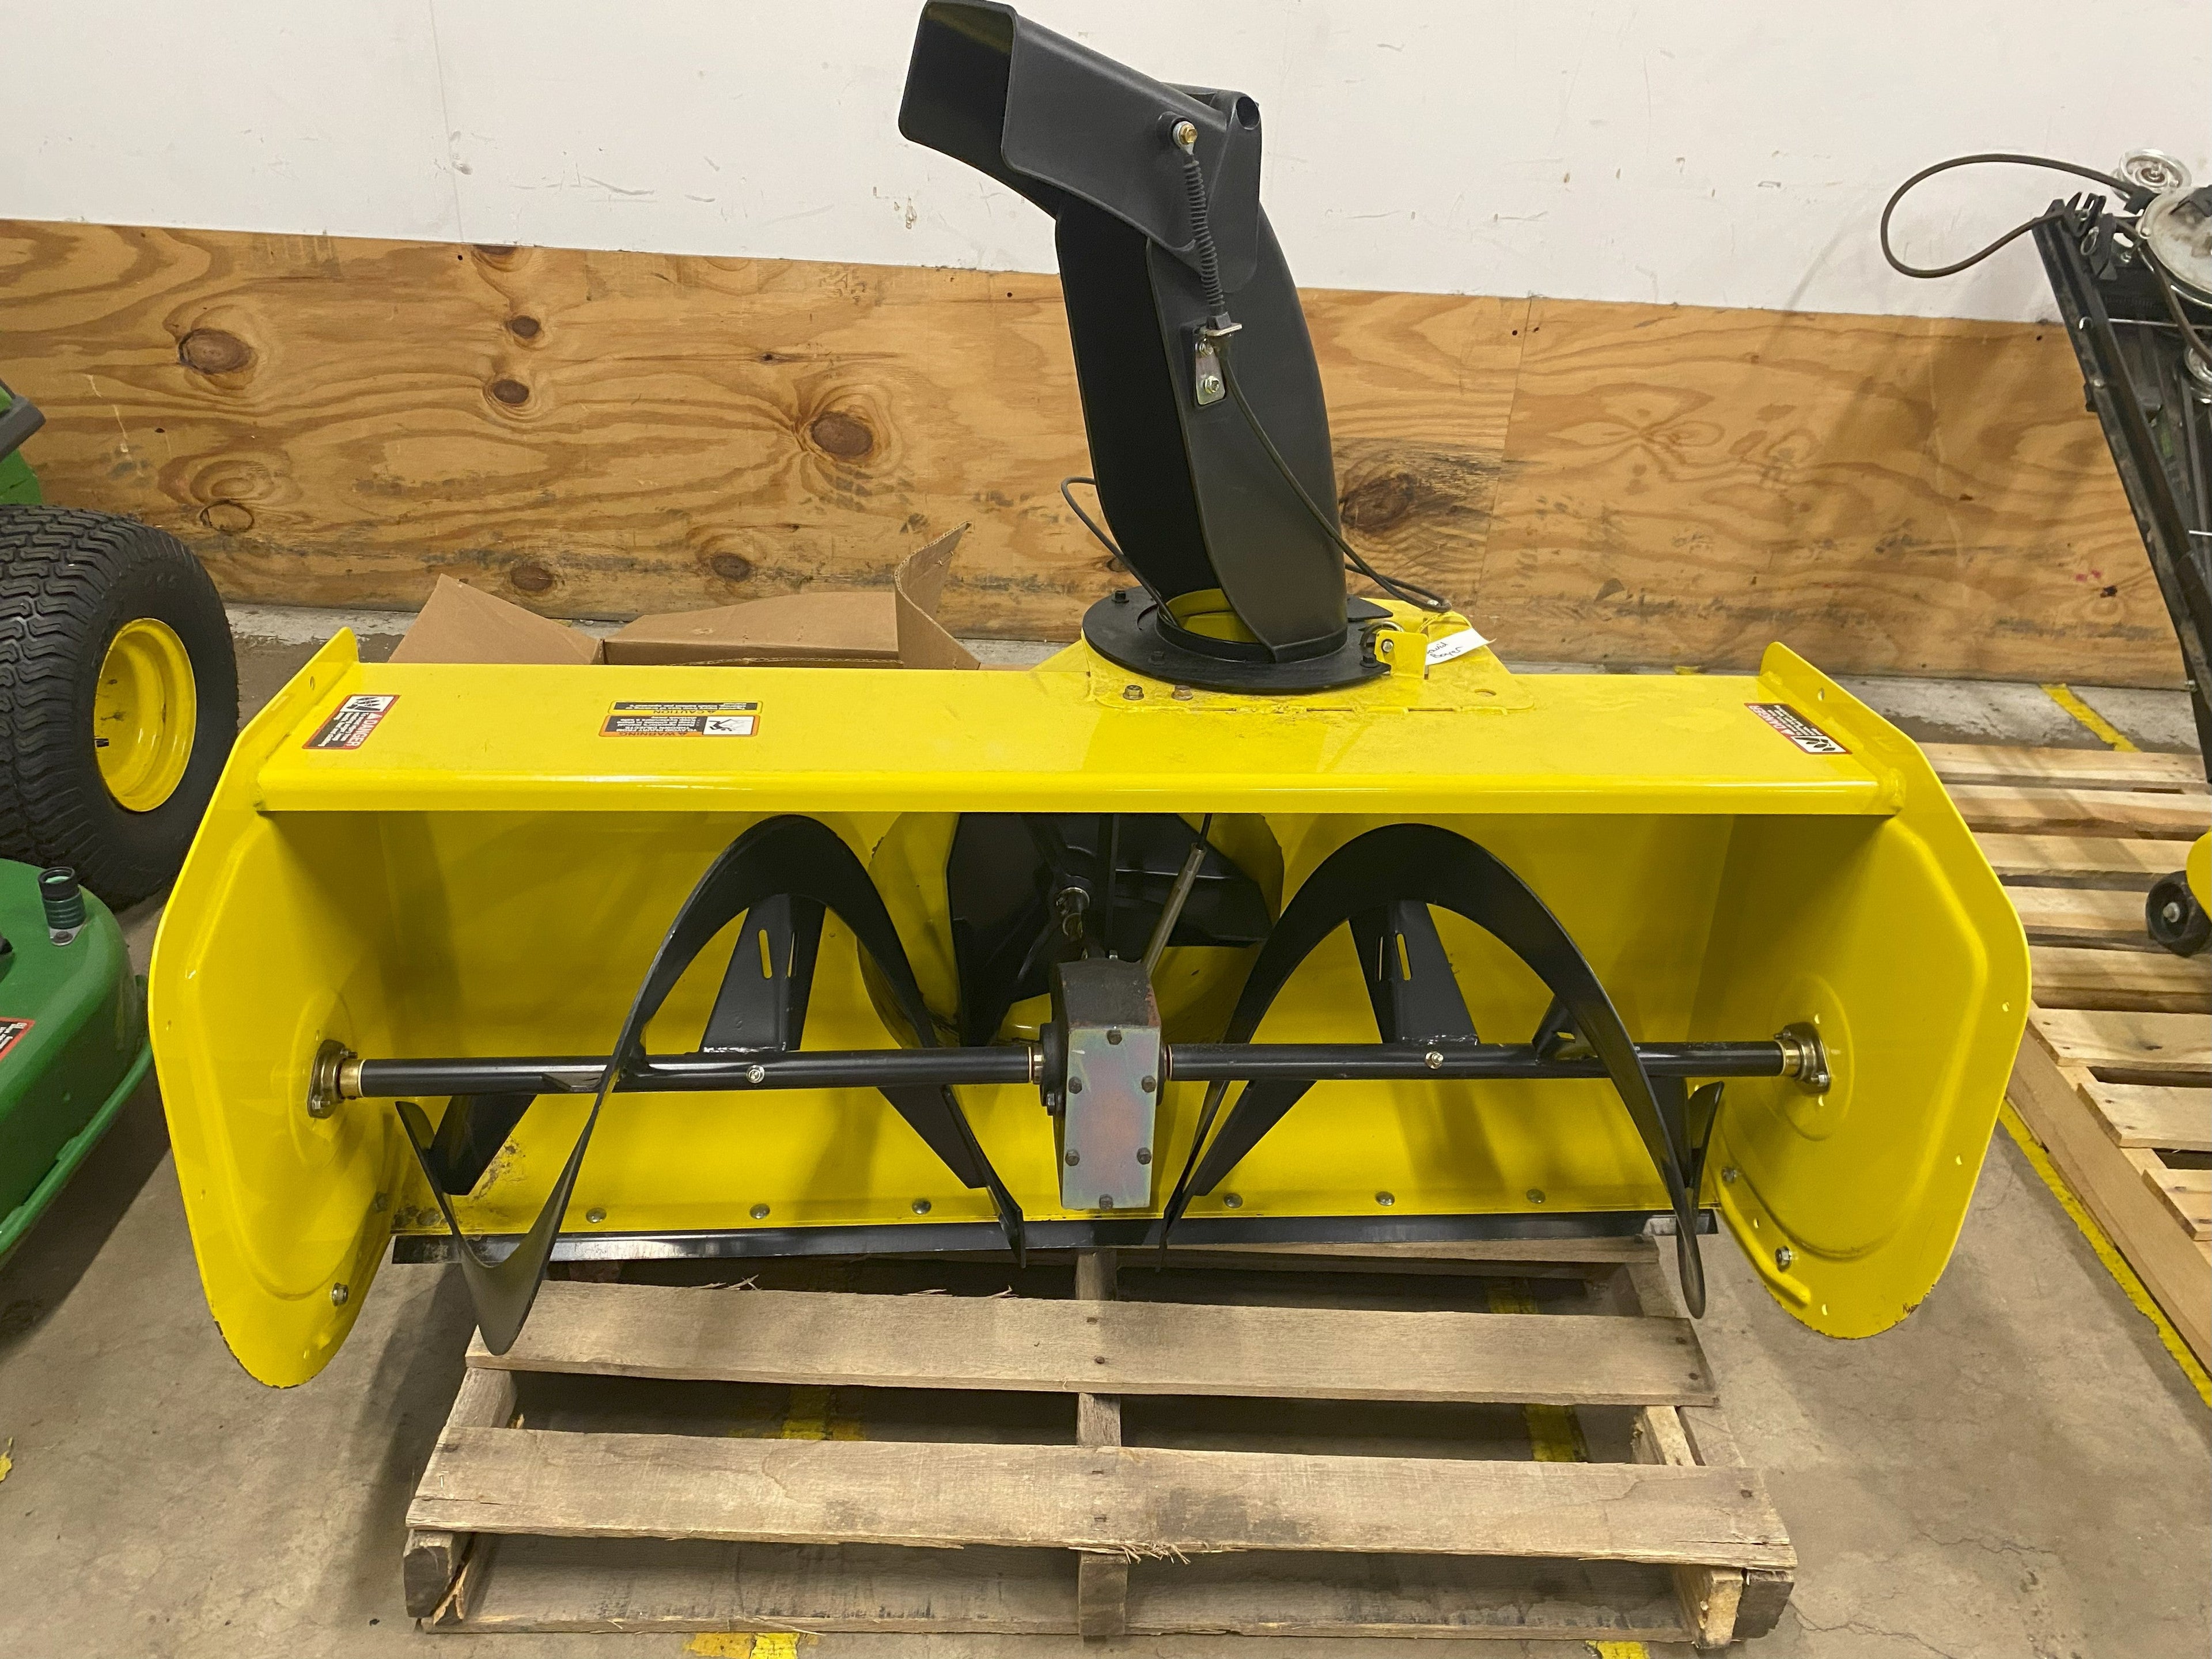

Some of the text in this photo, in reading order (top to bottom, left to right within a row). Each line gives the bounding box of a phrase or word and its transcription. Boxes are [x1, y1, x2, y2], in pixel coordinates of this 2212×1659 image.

[1427, 642, 1448, 654] avid
[1748, 705, 1787, 729] DANGER
[346, 720, 379, 747] DANGER
